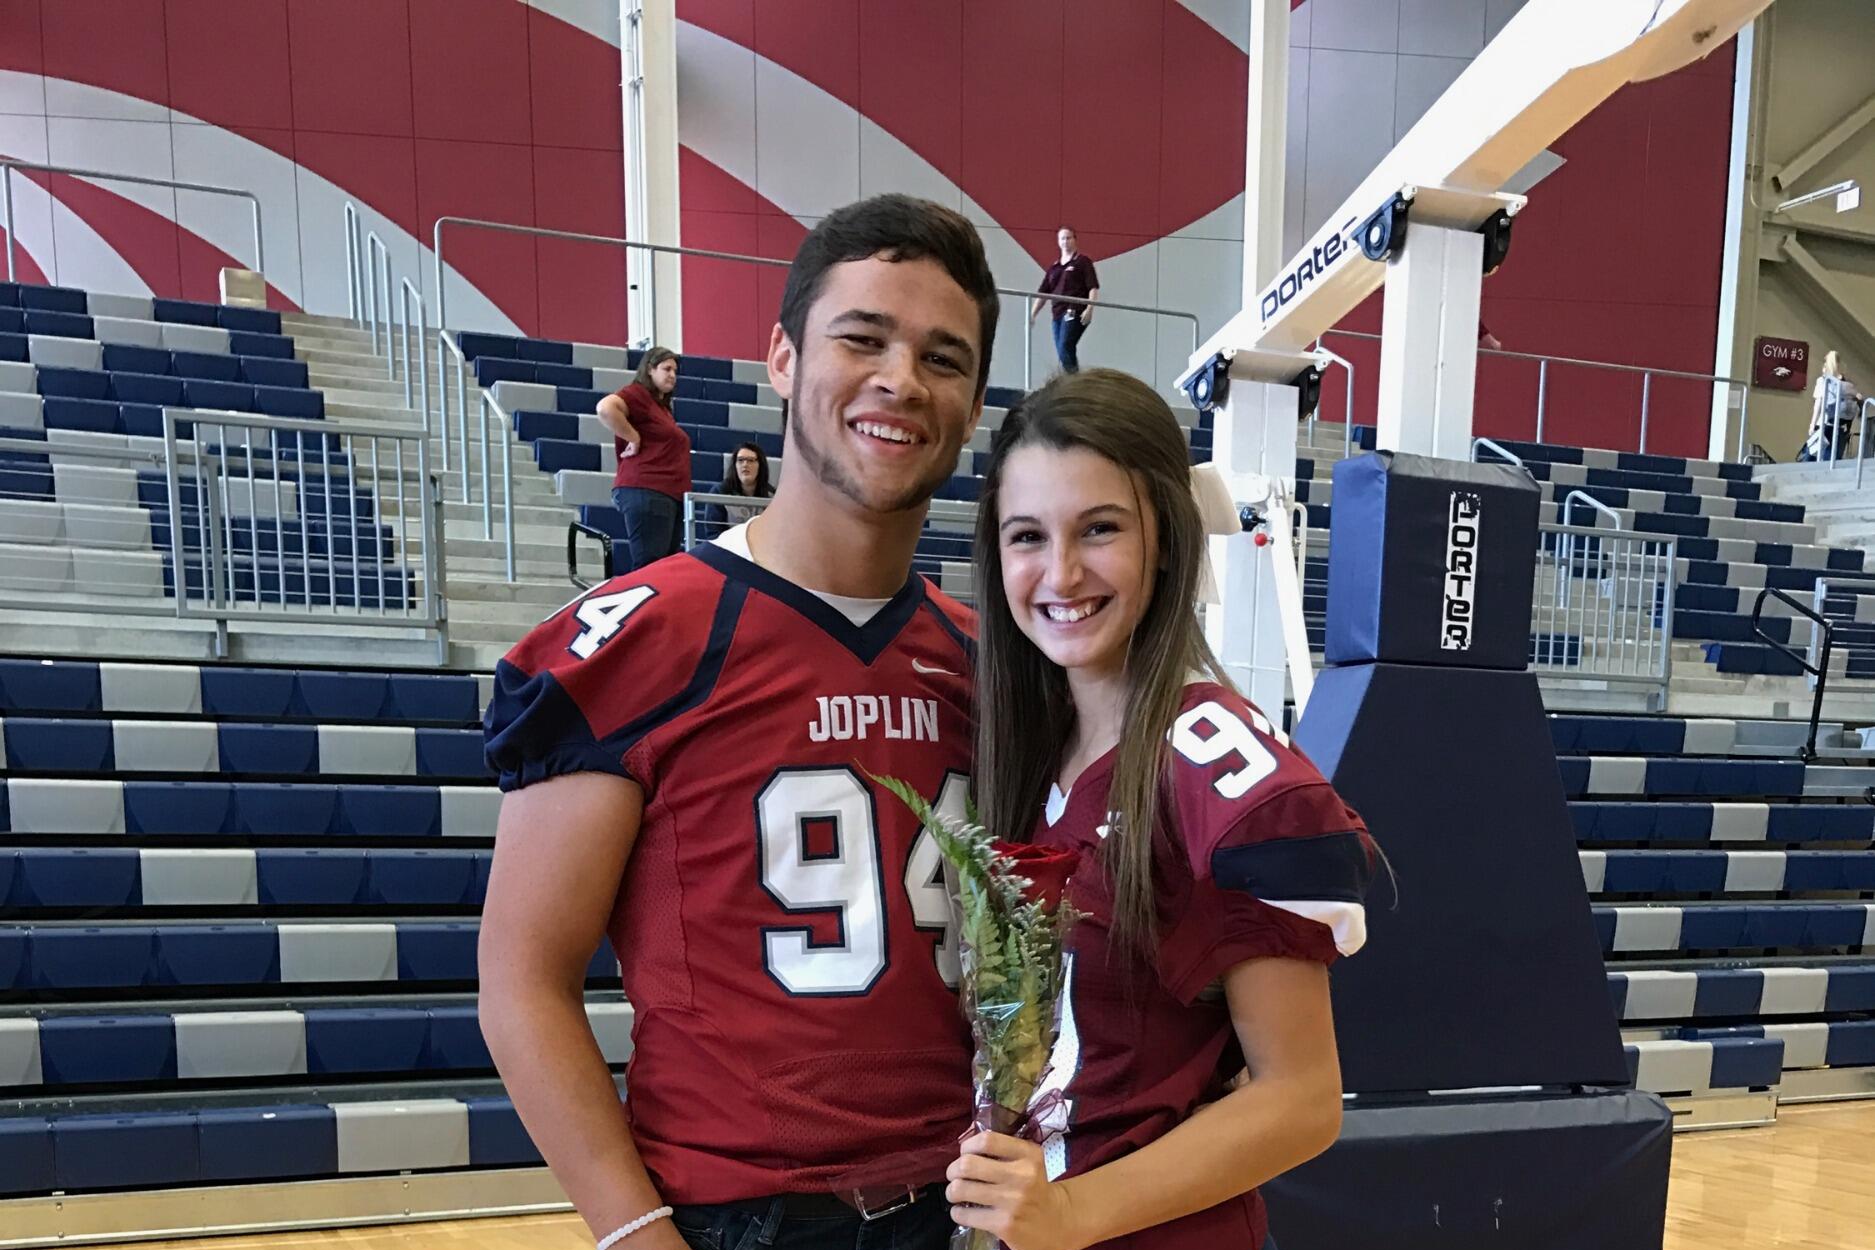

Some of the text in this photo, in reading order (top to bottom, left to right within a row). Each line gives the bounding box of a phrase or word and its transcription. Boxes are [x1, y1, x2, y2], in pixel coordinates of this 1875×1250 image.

[1763, 344, 1804, 361] GYM #3
[542, 584, 659, 660] 4
[808, 695, 939, 742] JOPLIN
[1166, 700, 1289, 799] 9
